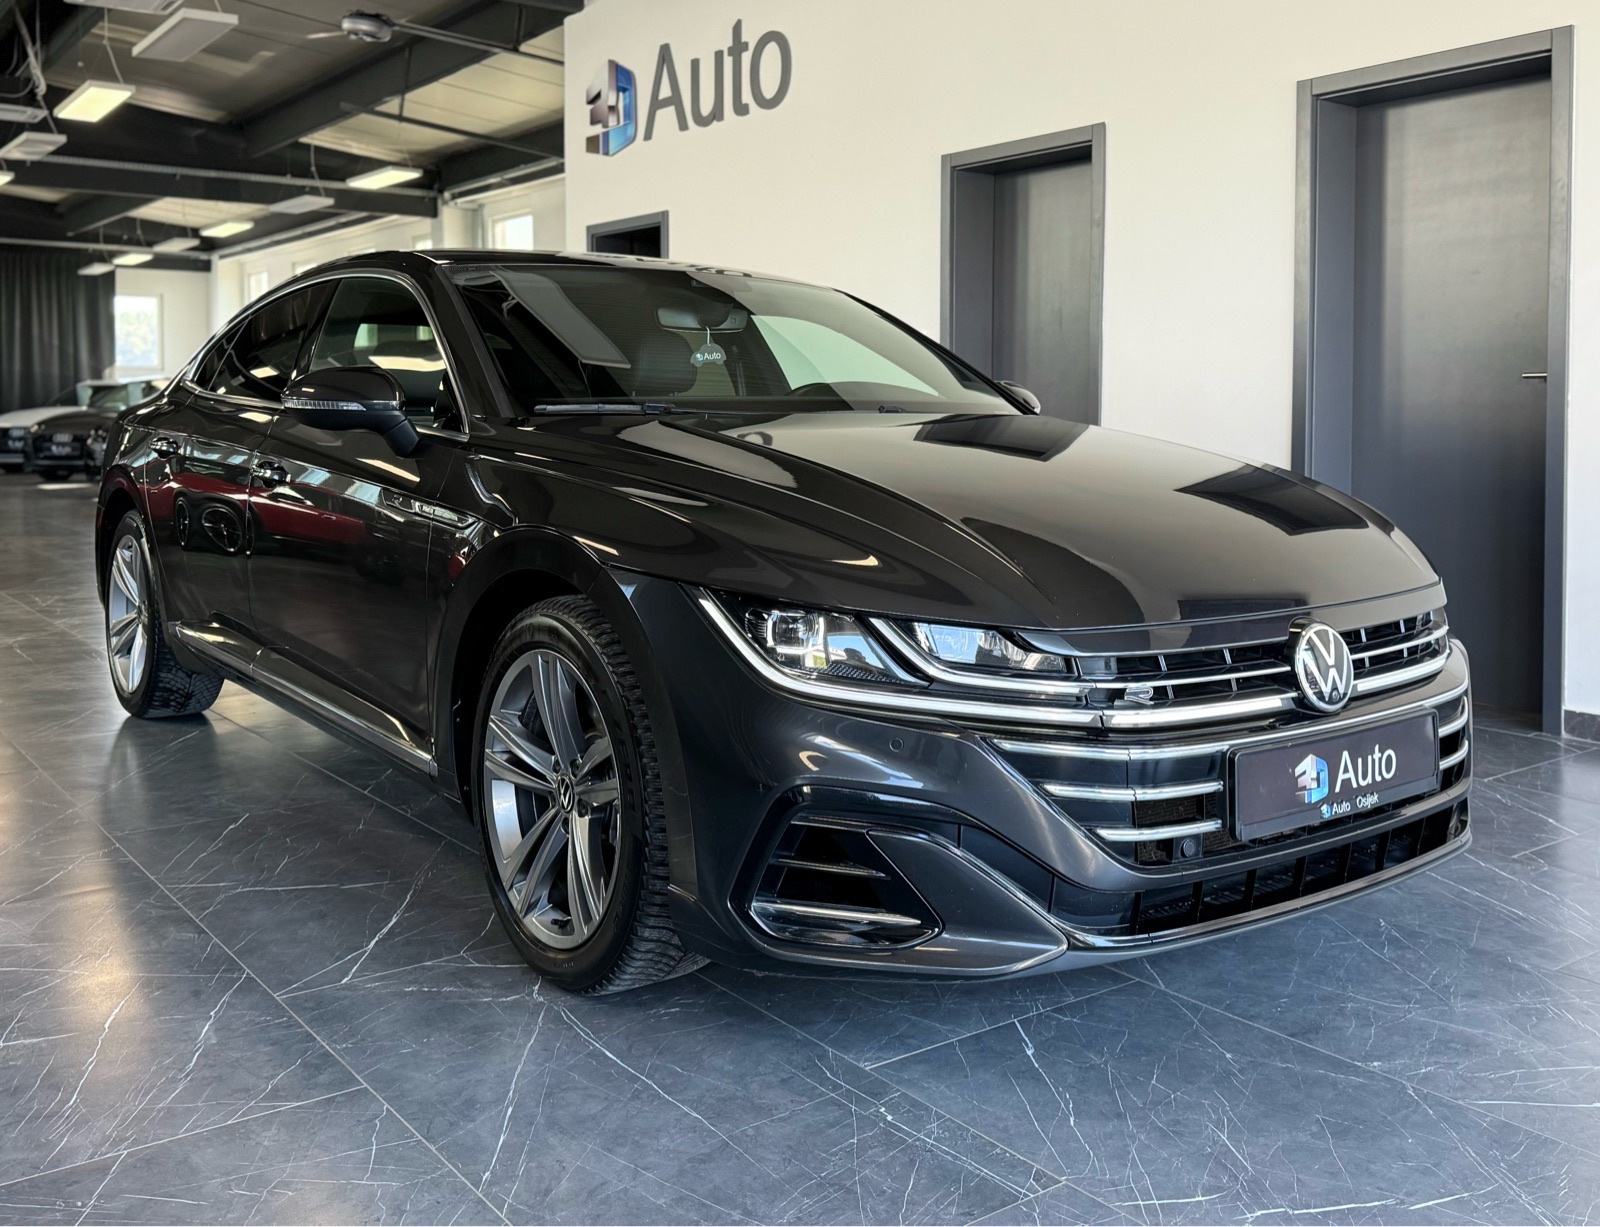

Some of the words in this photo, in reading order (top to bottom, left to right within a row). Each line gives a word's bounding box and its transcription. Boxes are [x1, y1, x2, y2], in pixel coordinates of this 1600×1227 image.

[643, 18, 792, 141] Auto
[1334, 743, 1397, 793] Auto
[1332, 800, 1351, 815] Auto
